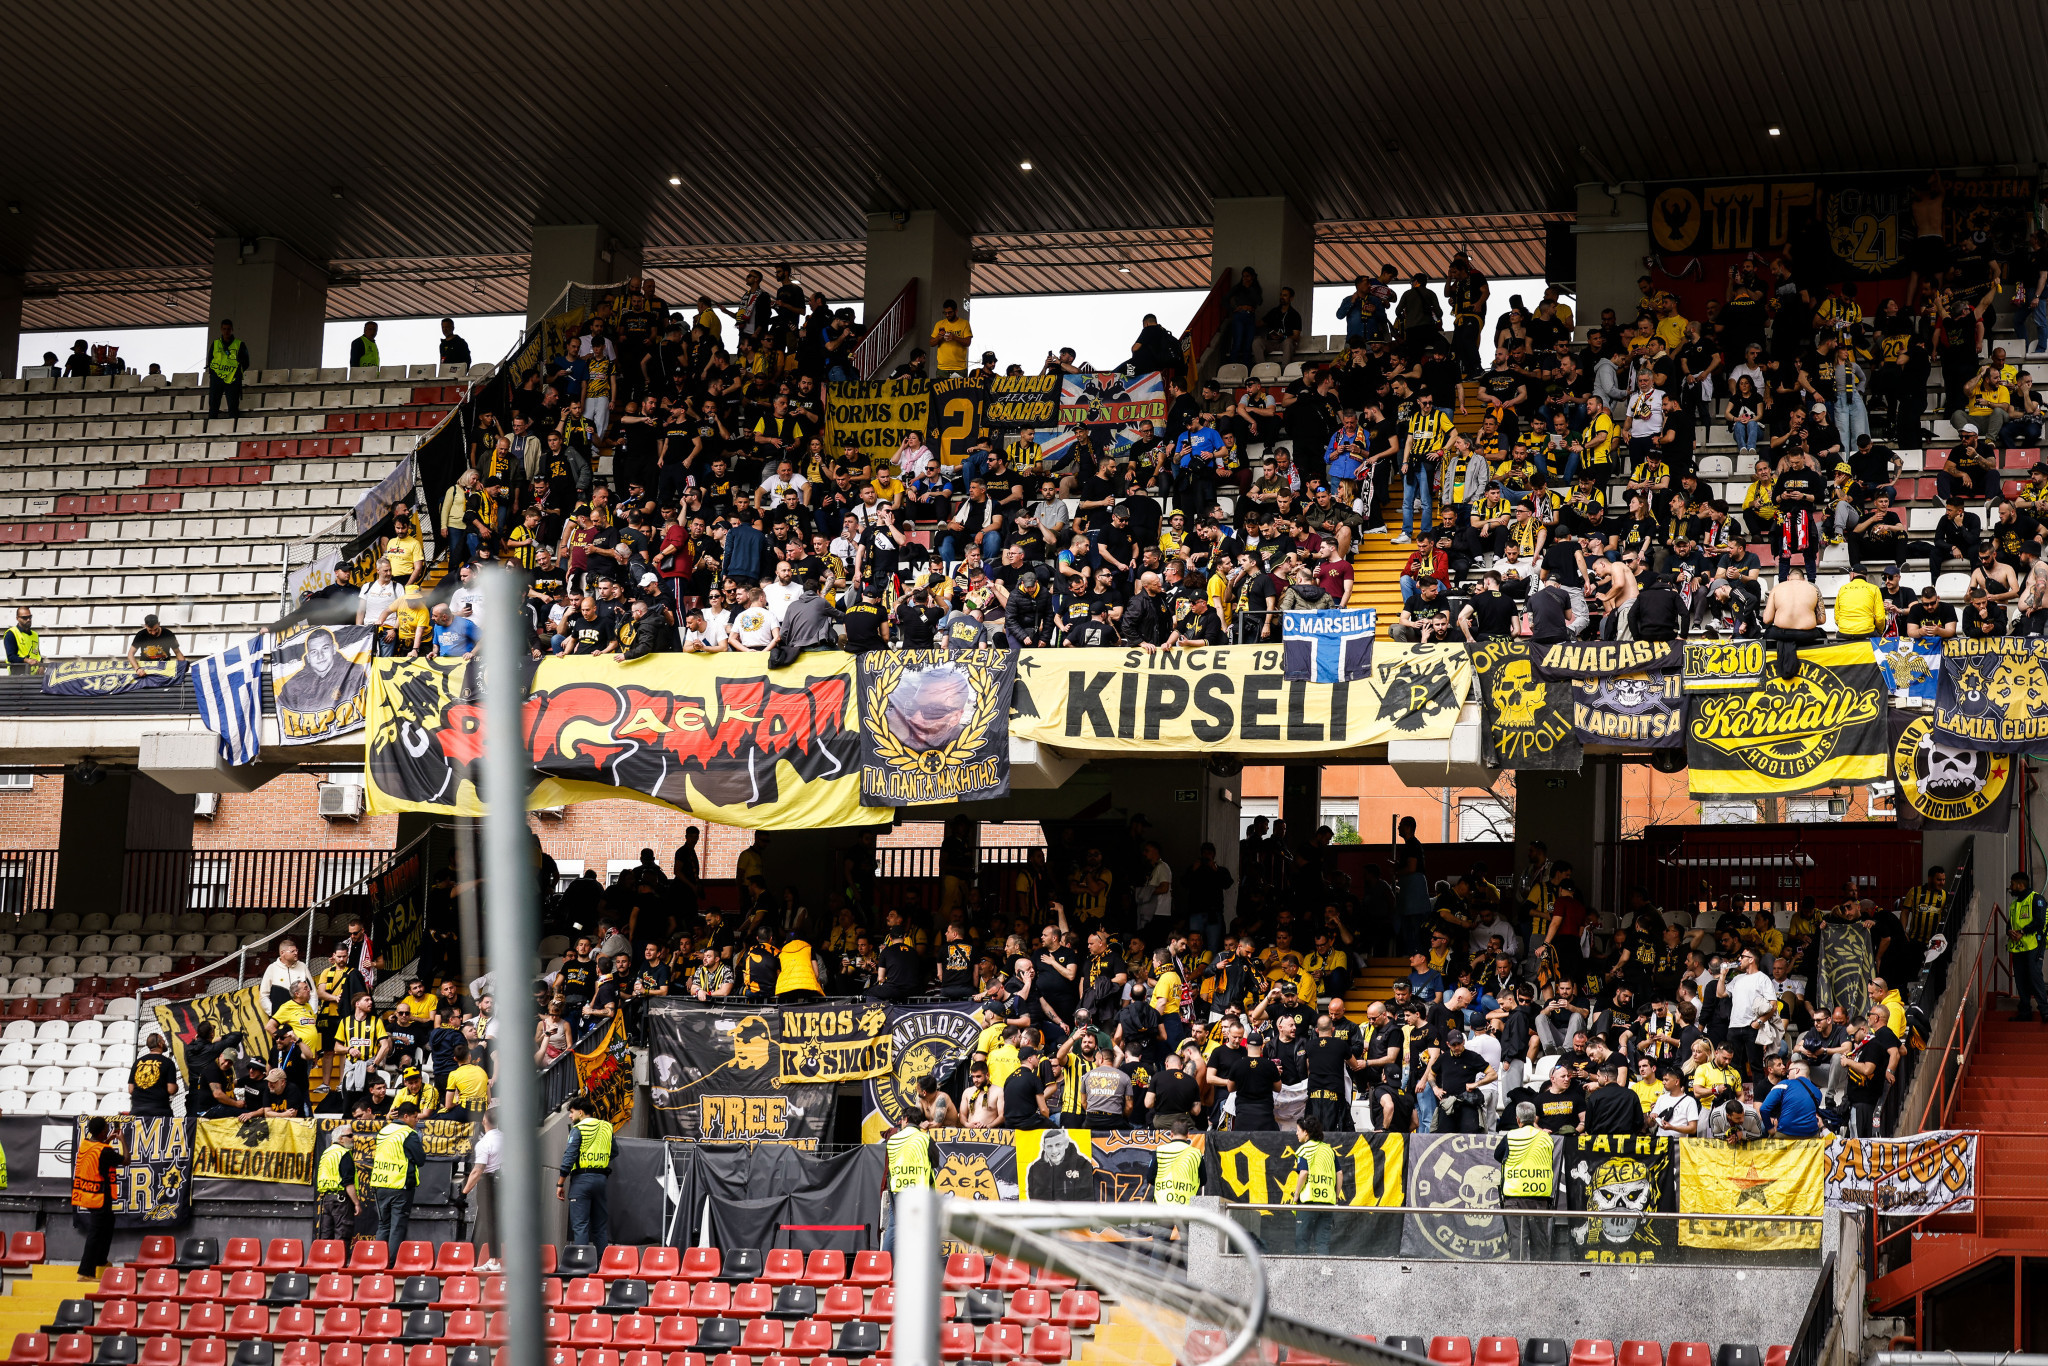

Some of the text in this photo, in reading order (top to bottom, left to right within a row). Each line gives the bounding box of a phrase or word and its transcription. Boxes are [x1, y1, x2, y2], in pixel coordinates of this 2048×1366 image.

[1852, 212, 1898, 263] 21
[210, 361, 237, 373] ECURIT
[891, 378, 930, 397] ALL
[933, 377, 984, 395] ANTIFASC
[991, 375, 1058, 393] ΠΑΛΑΙΟ
[828, 403, 891, 424] FORMS
[899, 401, 926, 422] OF
[987, 402, 1056, 421] ΦΑΛΗΡΟ
[1118, 402, 1165, 421] CLUB
[1283, 612, 1375, 634] O. MARSEILLE
[865, 648, 949, 674] ΜΙΧΑΛΗ
[1124, 650, 1230, 671] SINCE
[1540, 640, 1672, 672] ANACASA
[1064, 670, 1350, 742] KIPSELI
[1573, 702, 1681, 741] KARDITSA
[1936, 708, 1998, 741] LAMIA
[1897, 726, 1922, 757] ANO
[1746, 738, 1833, 776] HOOLIGANS
[863, 766, 886, 796] ΓΙΑ
[937, 757, 999, 797] ΜΑΧΗΤΗΣ
[1914, 792, 1990, 820] ORIGINAL 21
[783, 1010, 853, 1037] NEOS
[876, 1076, 902, 1124] ALWAY
[424, 1119, 475, 1136] SOUTH
[701, 1097, 787, 1138] FREE
[422, 1136, 456, 1154] SIDE
[1451, 1134, 1501, 1153] CLU
[193, 1145, 313, 1181] ΑΜΠΕΛΟΚΗΠΟΙ
[374, 1160, 404, 1172] CURITY
[580, 1152, 610, 1162] ECURIT
[892, 1166, 929, 1176] ECURITY
[940, 1177, 990, 1189] A.E.K
[1155, 1180, 1196, 1193] SECURITY
[1418, 1180, 1431, 1197] 9
[1522, 1182, 1547, 1193] 200
[1166, 1192, 1187, 1205] 030
